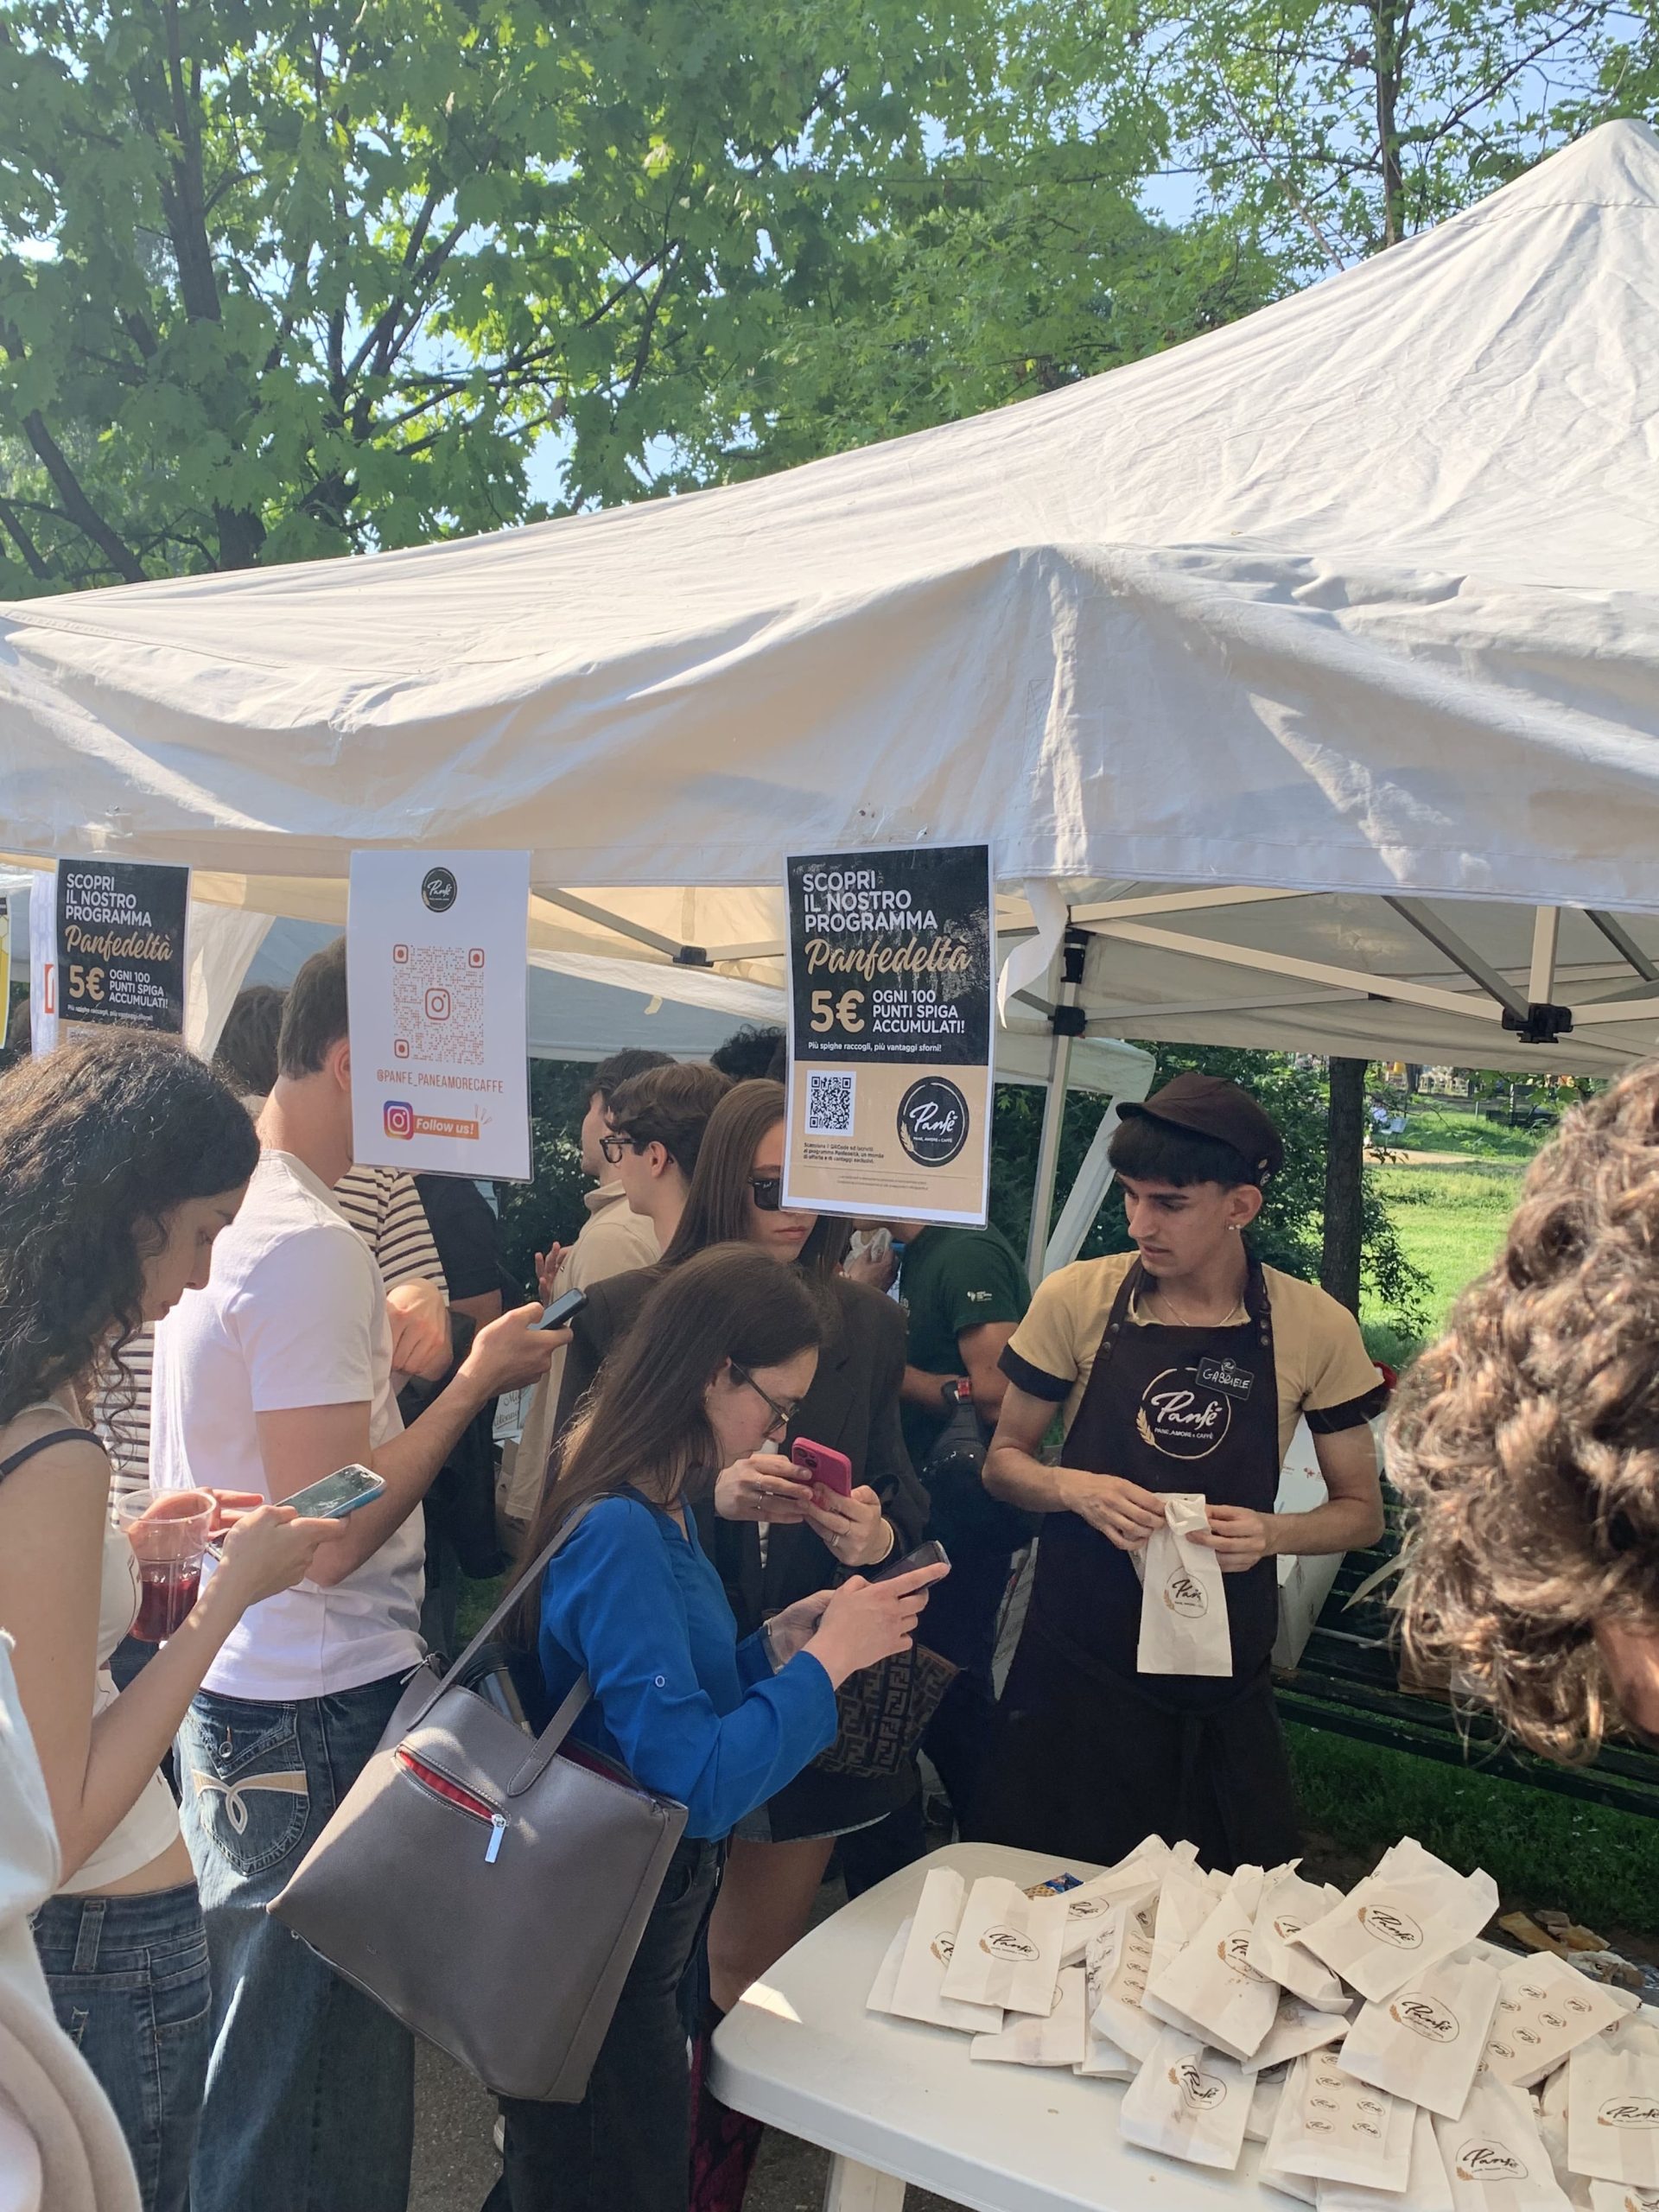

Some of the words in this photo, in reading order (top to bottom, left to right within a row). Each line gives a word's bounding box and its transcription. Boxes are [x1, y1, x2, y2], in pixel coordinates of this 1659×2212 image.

[67, 874, 114, 891] SCOPRI
[803, 871, 876, 892] SCOPRI
[67, 889, 78, 905] IL
[81, 891, 137, 909] NOSTRO
[804, 894, 821, 912] IL
[826, 890, 912, 912] NOSTRO
[65, 906, 152, 926] PROGRAMMA
[805, 910, 938, 933] PROGRAMMA
[65, 925, 173, 962] Panfedeltà
[804, 936, 972, 982] Panfedeltà
[69, 964, 105, 1001] 5€
[109, 969, 132, 982] OGNI
[135, 972, 150, 983] 100
[109, 980, 135, 993] PUNTI
[137, 984, 164, 996] SPIGA
[873, 990, 907, 1003] OGNI
[912, 990, 936, 1003] 100
[109, 994, 168, 1009] ACCUMULATI!
[810, 989, 865, 1033] 5€
[873, 1005, 912, 1018] PUNTI
[917, 1005, 958, 1019] SPIGA
[873, 1020, 964, 1033] ACCUMULATI!
[820, 1042, 842, 1051] spighe
[843, 1042, 873, 1052] raccogli,
[874, 1043, 886, 1052] più
[887, 1044, 918, 1052] vantaggi
[377, 1069, 504, 1094] @PANFE_PANEAMORECAFFE
[416, 1118, 454, 1134] Follow
[456, 1122, 474, 1135] us!
[1202, 1368, 1251, 1389] GABRIELE
